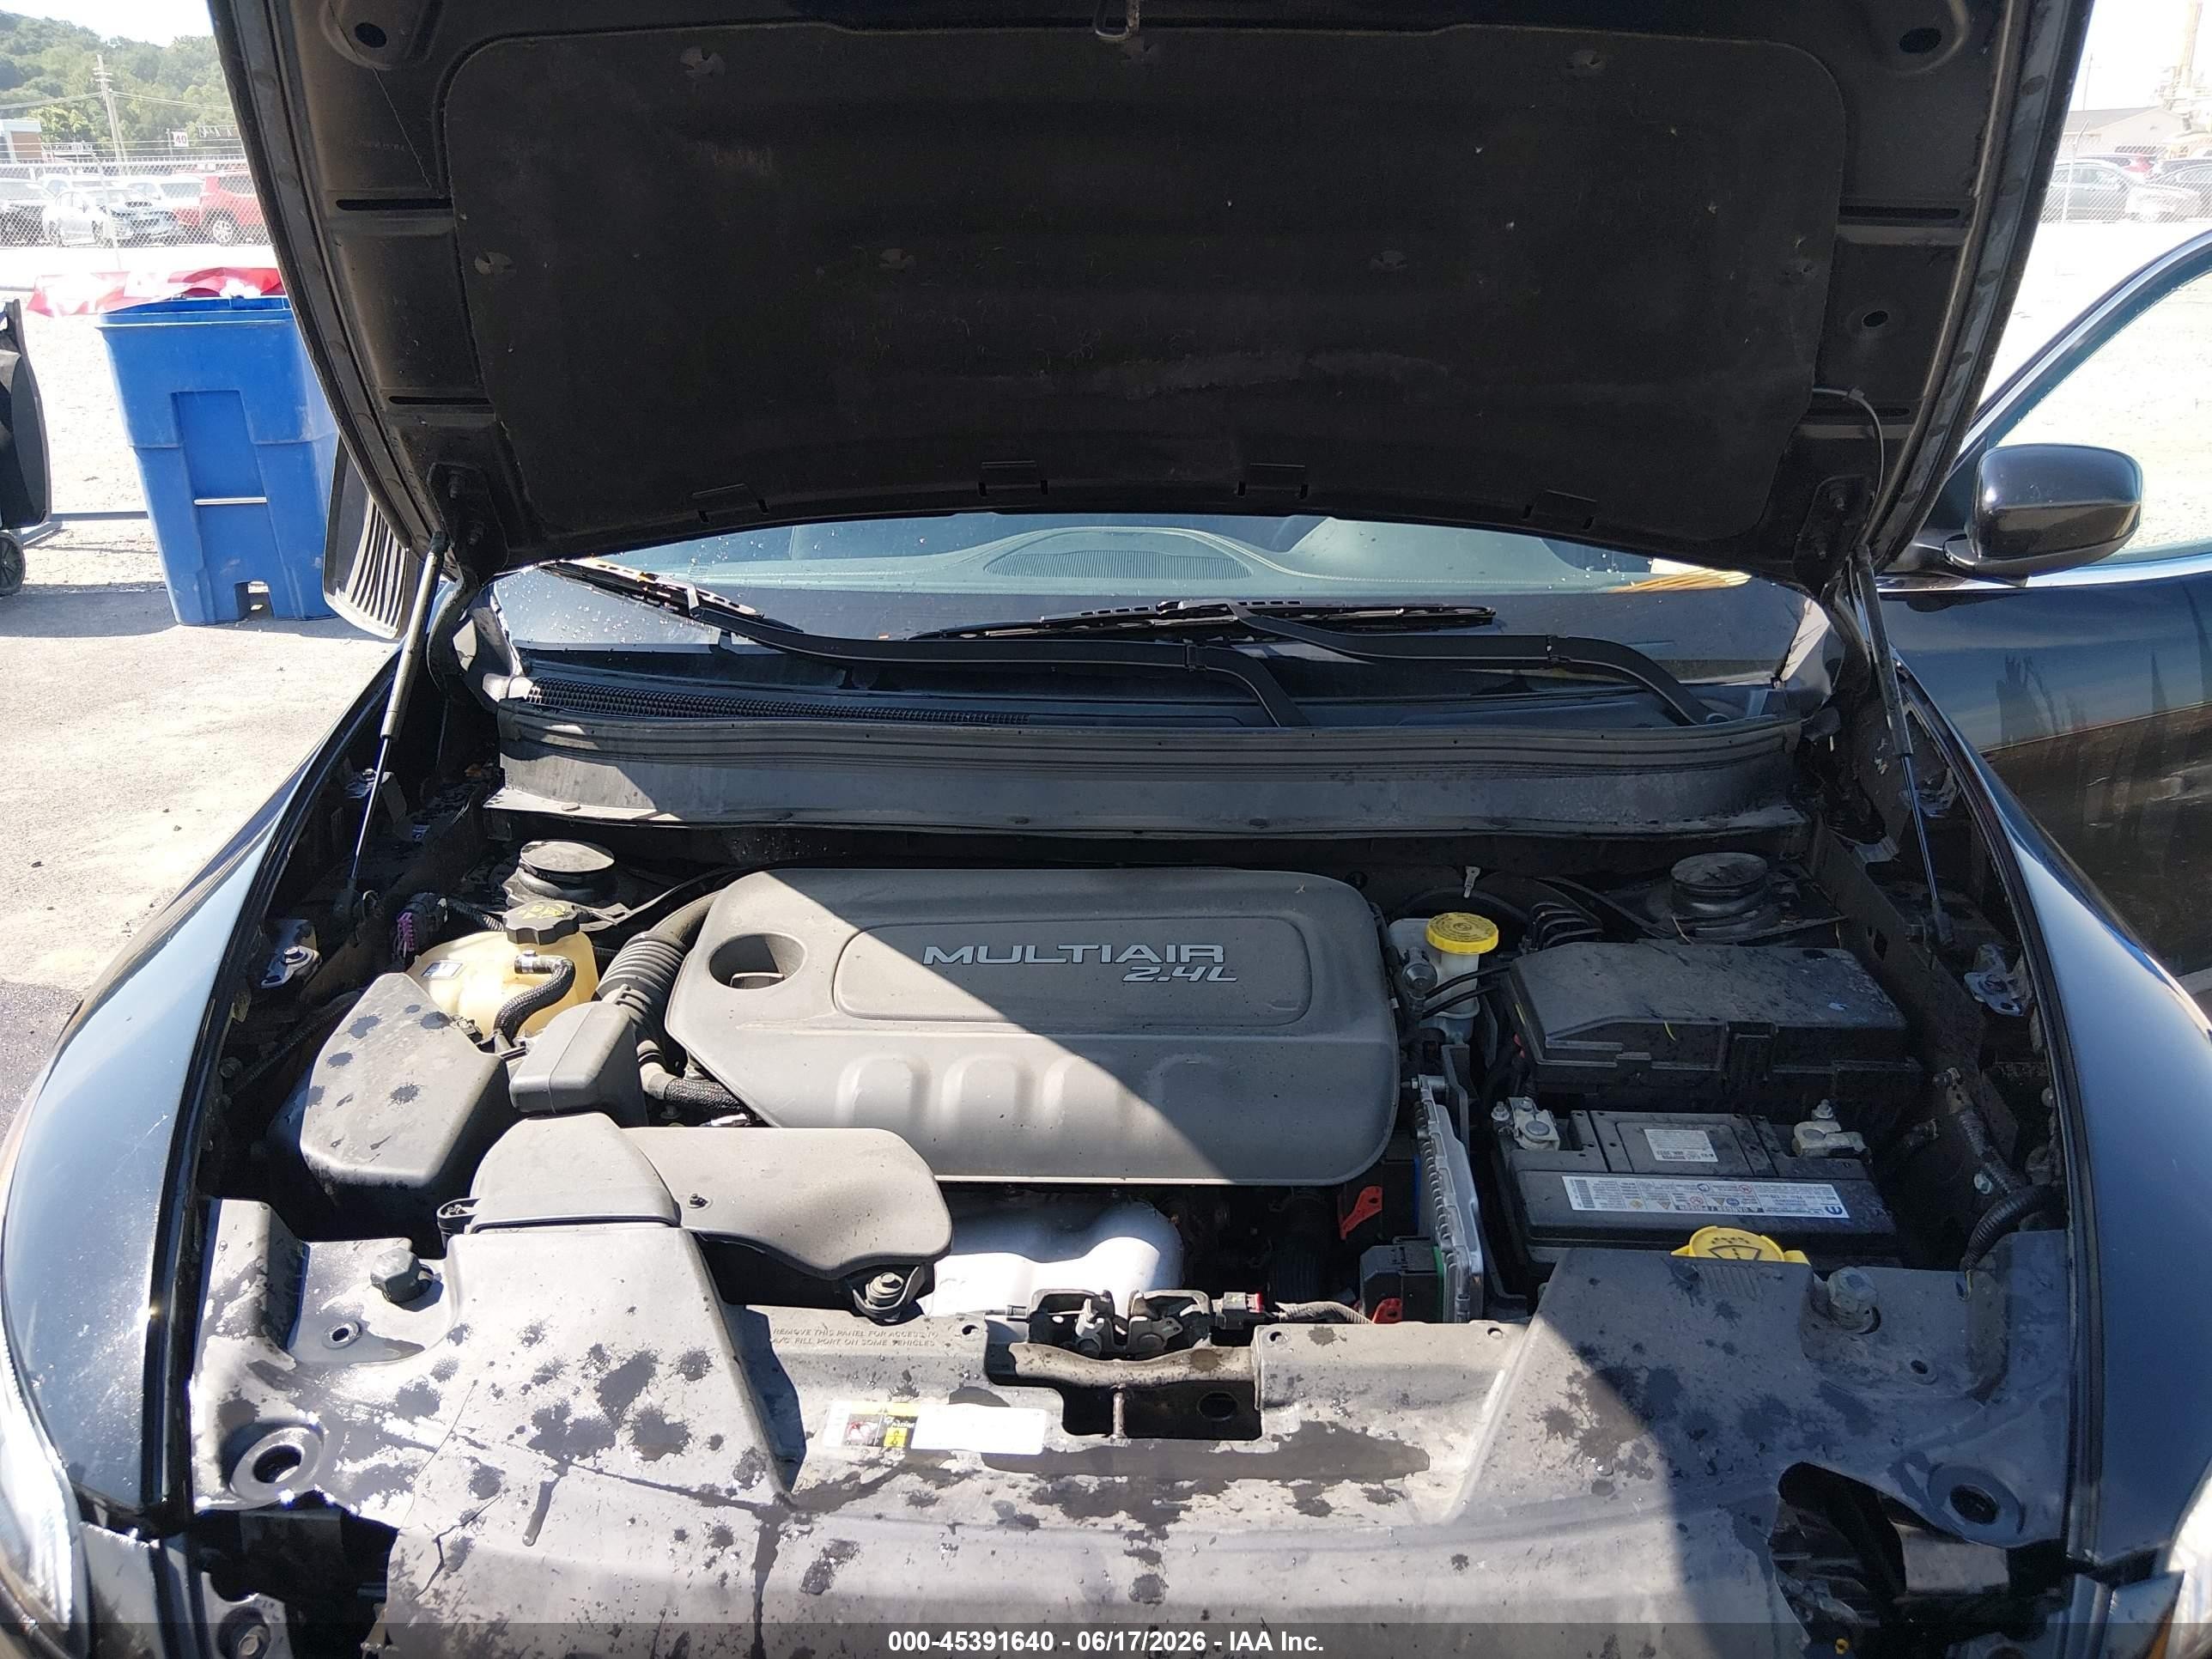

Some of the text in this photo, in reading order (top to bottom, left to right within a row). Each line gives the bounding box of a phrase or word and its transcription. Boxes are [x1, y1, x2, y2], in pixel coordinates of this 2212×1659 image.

[175, 136, 187, 144] 40
[921, 944, 1225, 965] MULTIAIR
[1121, 965, 1239, 984] 2.4L
